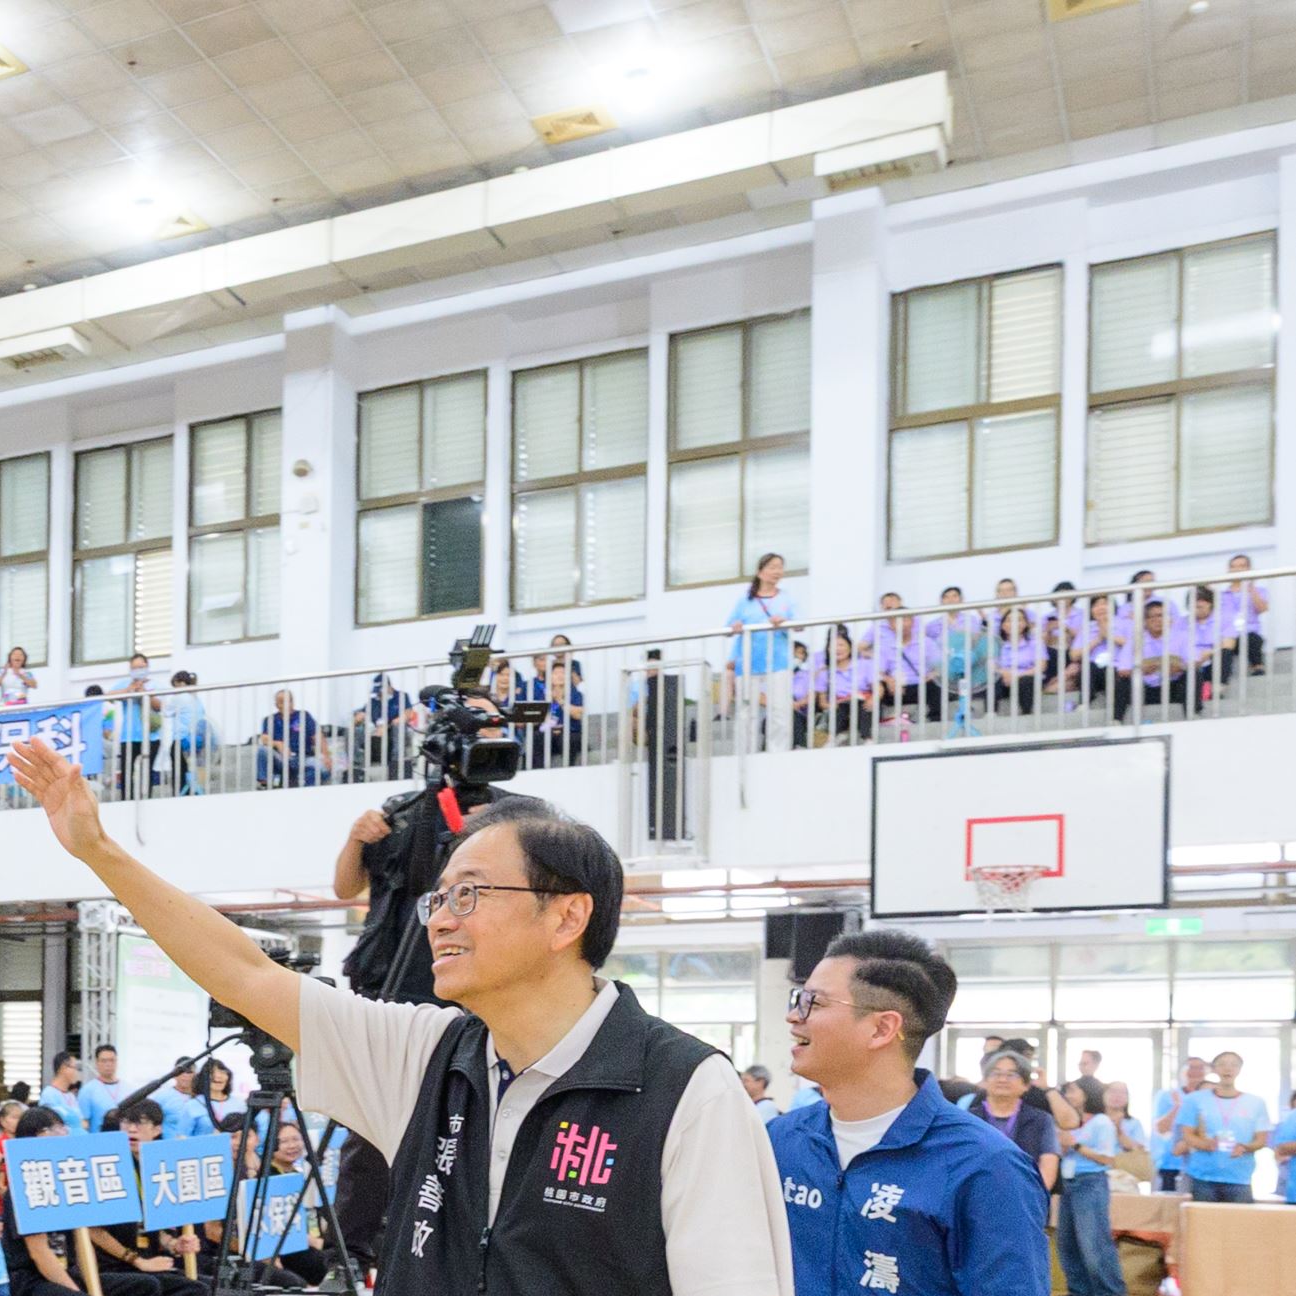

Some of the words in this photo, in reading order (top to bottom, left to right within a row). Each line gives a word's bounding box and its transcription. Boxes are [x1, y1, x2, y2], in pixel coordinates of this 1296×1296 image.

[20, 1154, 127, 1209] 觀音區
[151, 1154, 227, 1207] 大園區
[783, 1176, 822, 1209] tao
